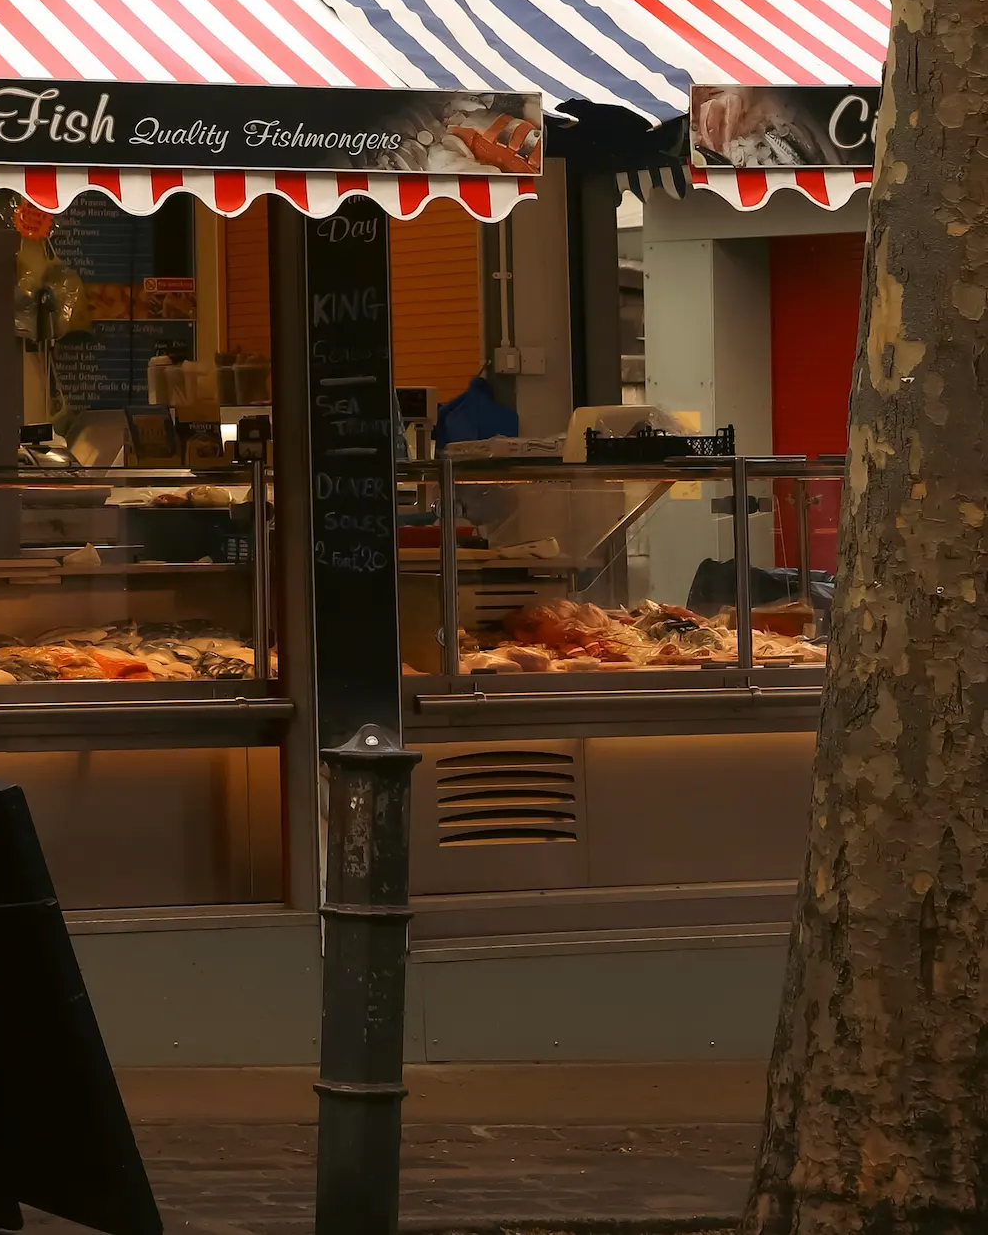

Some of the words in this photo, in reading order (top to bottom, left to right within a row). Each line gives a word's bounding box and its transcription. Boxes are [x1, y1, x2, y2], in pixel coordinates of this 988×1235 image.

[129, 116, 229, 154] Quality
[243, 119, 402, 156] Fishmongers
[88, 208, 119, 218] Herrings
[316, 215, 379, 243] Day
[312, 286, 386, 327] KING
